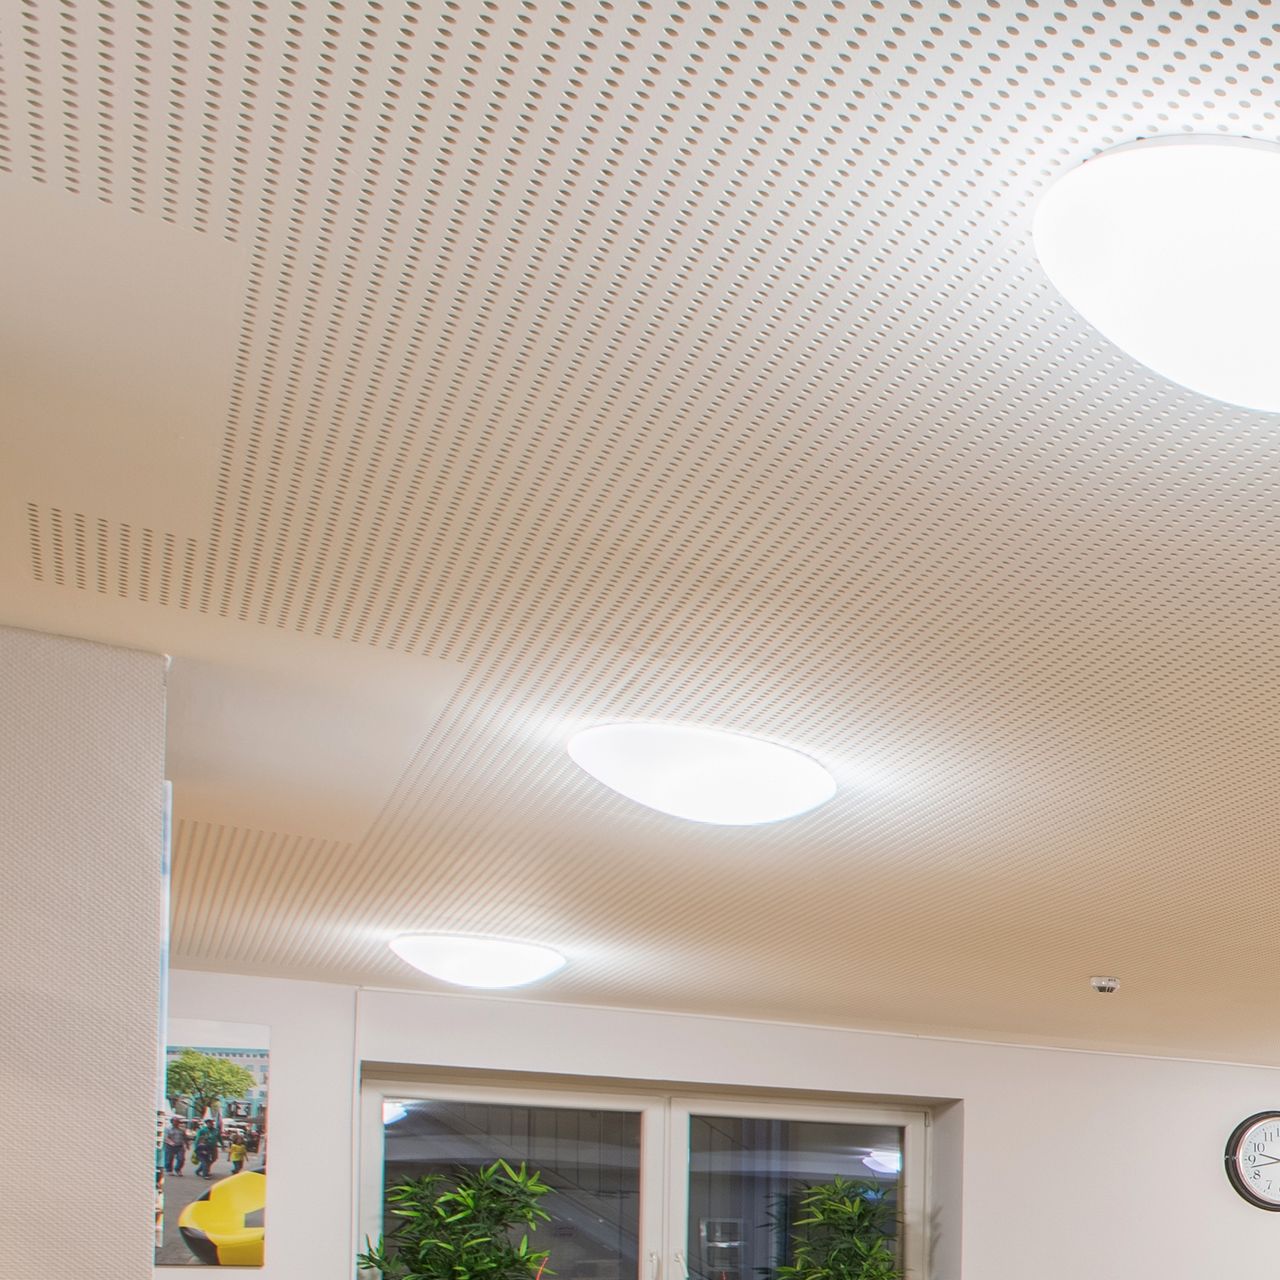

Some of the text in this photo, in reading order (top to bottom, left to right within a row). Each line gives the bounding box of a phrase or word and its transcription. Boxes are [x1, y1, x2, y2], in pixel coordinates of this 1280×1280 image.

[1263, 1131, 1273, 1142] 11
[1253, 1142, 1265, 1153] 10
[1248, 1154, 1256, 1165] 9
[1252, 1169, 1261, 1180] 8
[1265, 1180, 1272, 1190] 7
